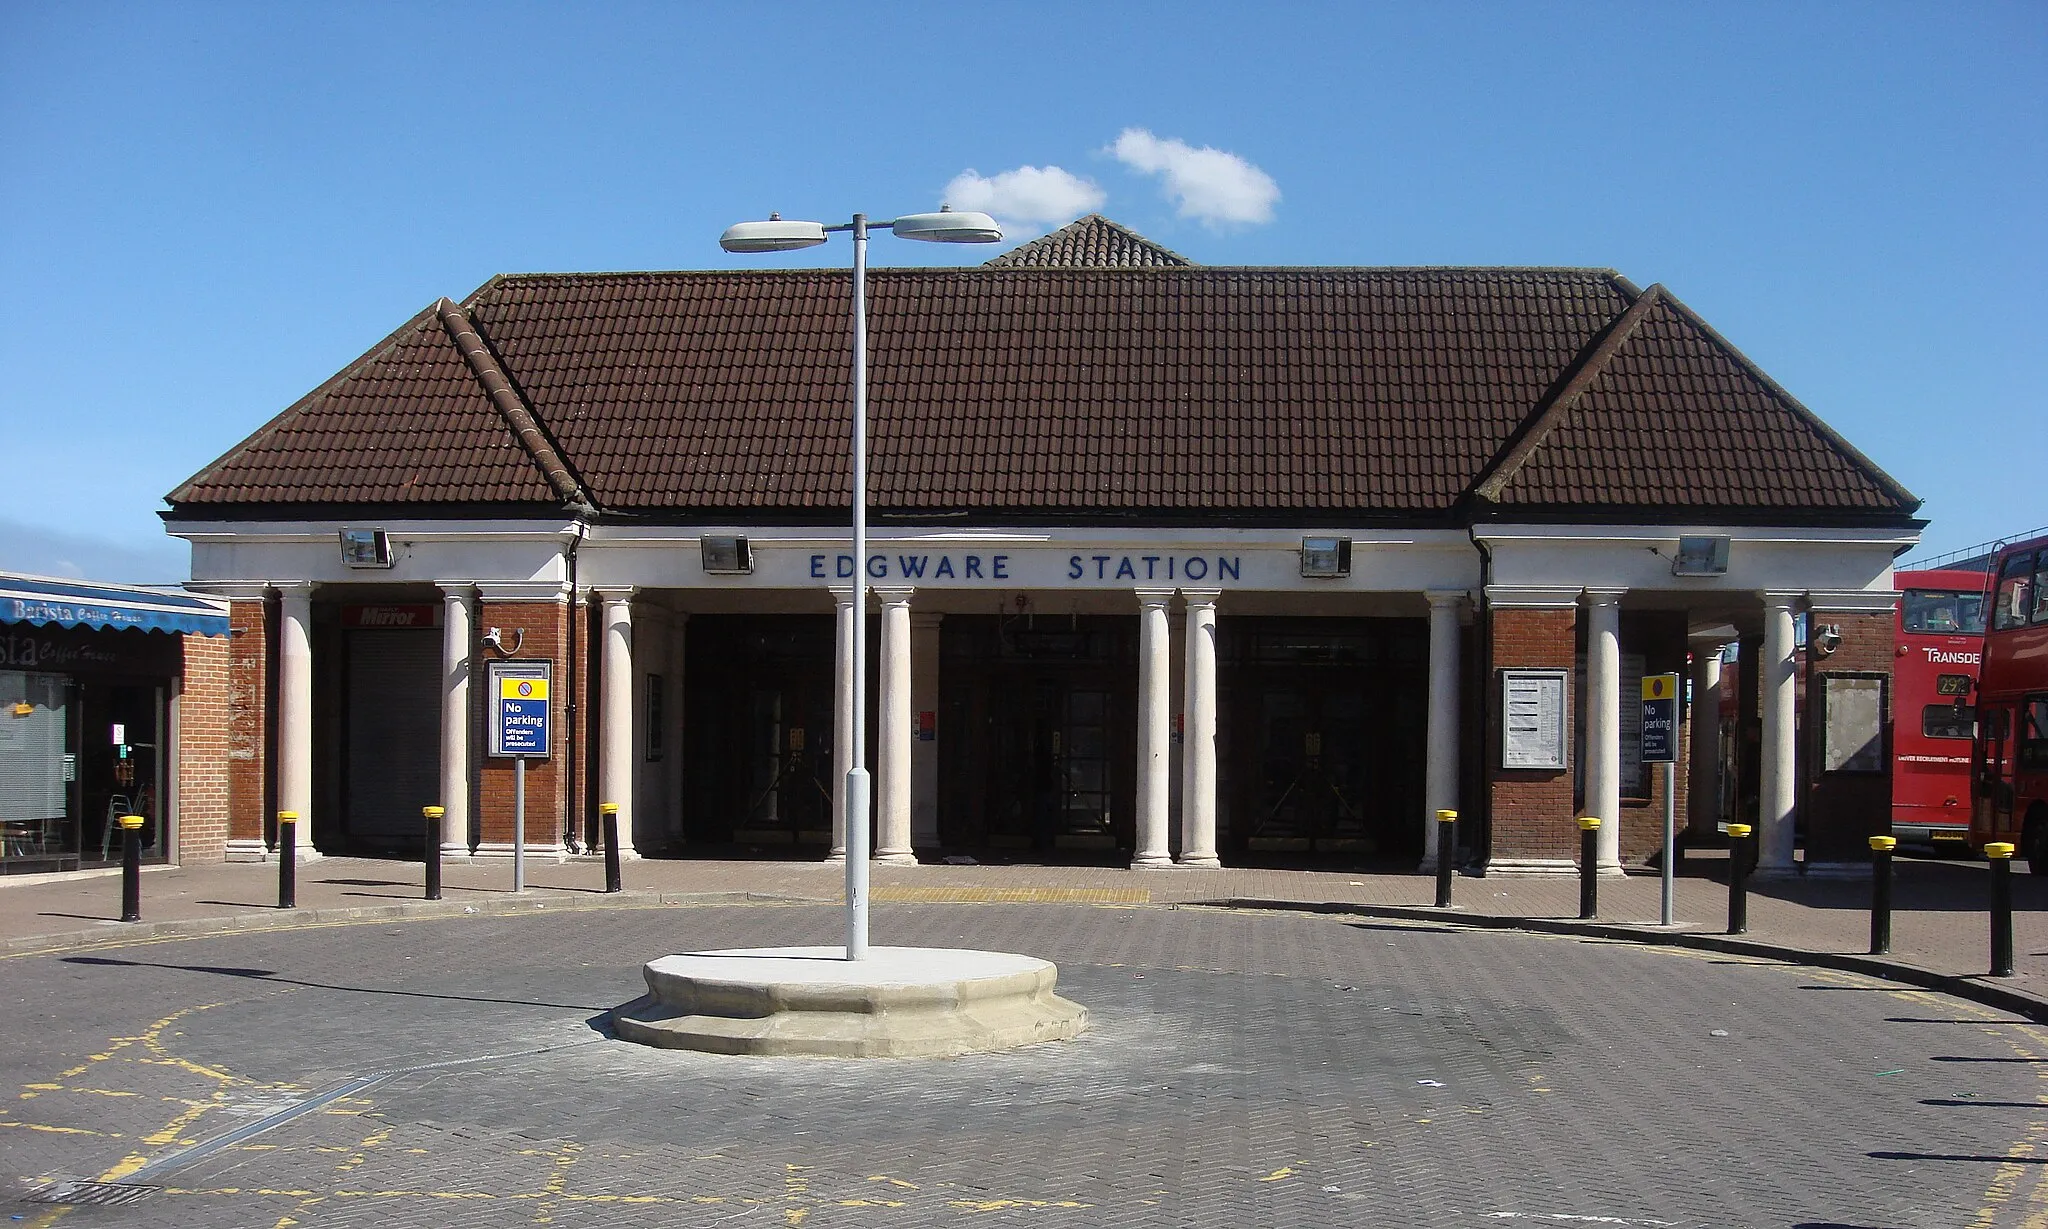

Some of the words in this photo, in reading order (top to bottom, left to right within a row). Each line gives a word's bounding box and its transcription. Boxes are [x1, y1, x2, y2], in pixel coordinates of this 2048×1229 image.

[810, 555, 1009, 579] EDGWARE
[1068, 556, 1240, 581] STATION
[13, 600, 73, 621] Barista
[360, 607, 416, 624] Mirror
[505, 702, 522, 713] No
[1645, 705, 1655, 715] No
[505, 714, 544, 728] parking
[1645, 718, 1671, 731] parking
